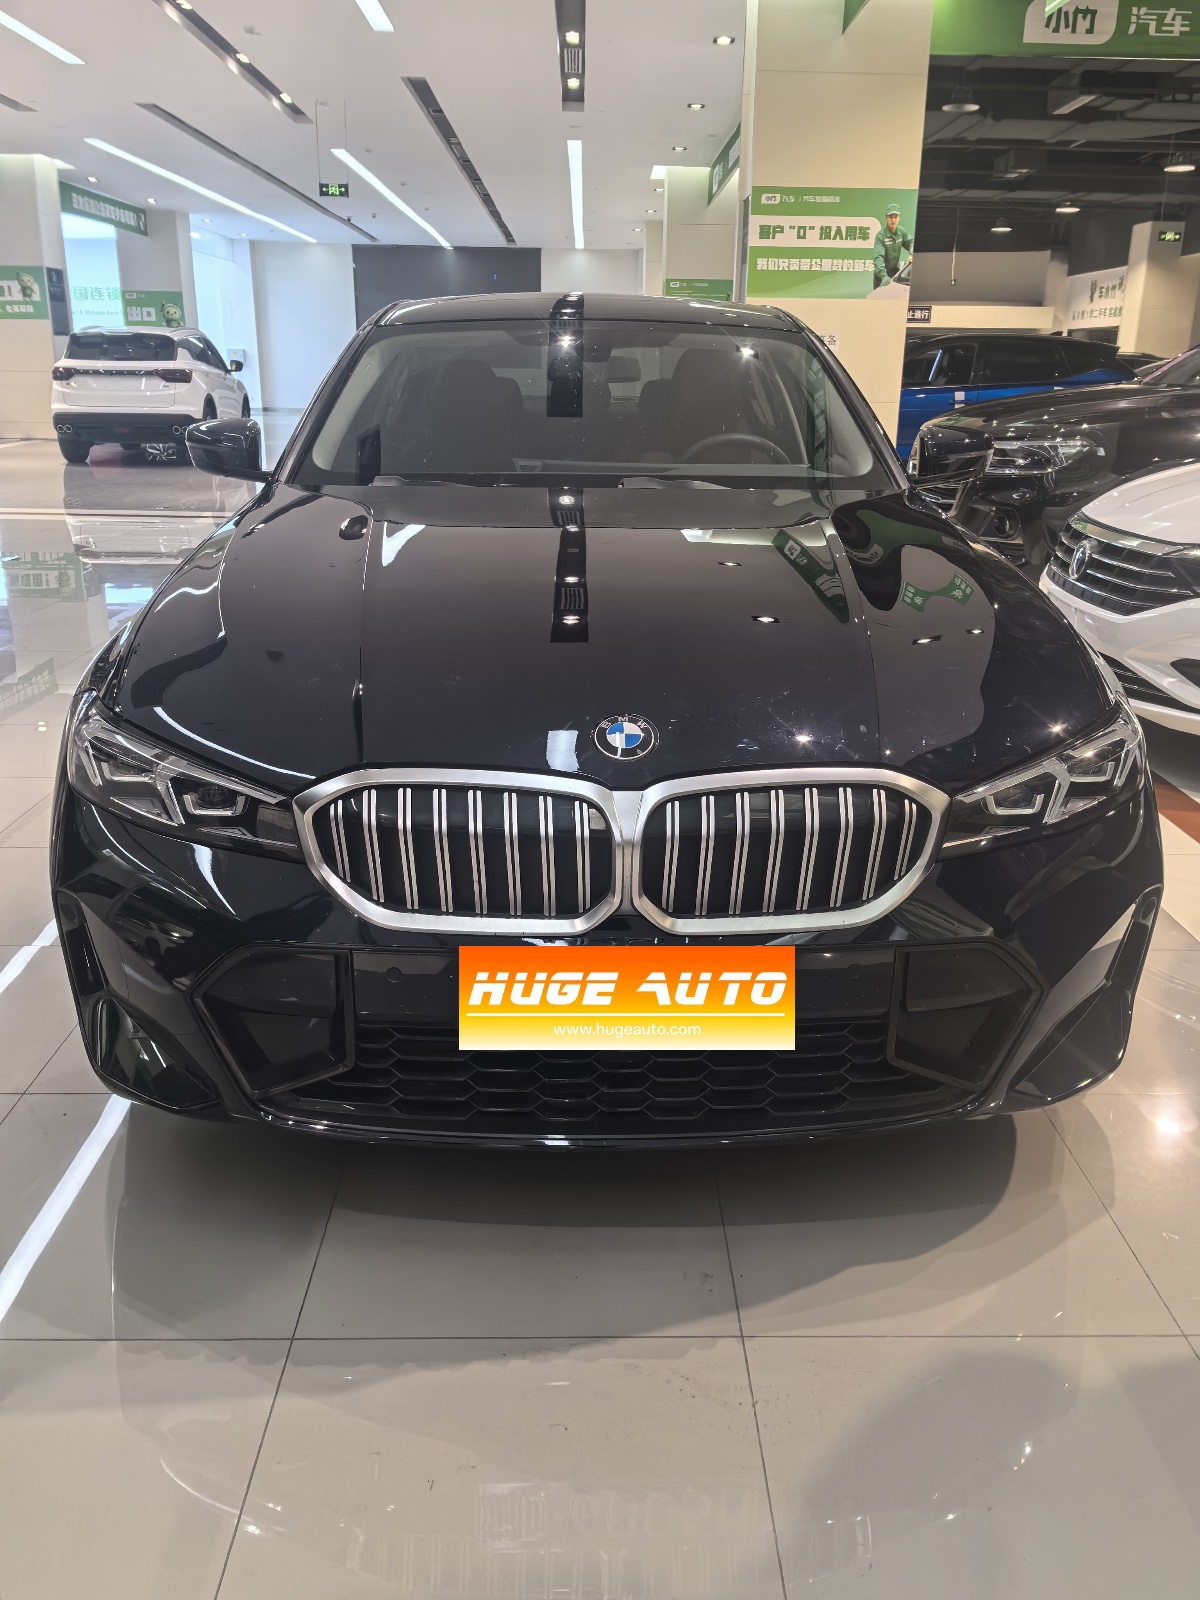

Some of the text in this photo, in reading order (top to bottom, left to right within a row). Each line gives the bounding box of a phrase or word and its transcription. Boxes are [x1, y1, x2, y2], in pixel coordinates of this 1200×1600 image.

[1044, 5, 1193, 37] 小竹 汽车
[126, 306, 157, 322] 出口
[600, 716, 648, 729] BMW
